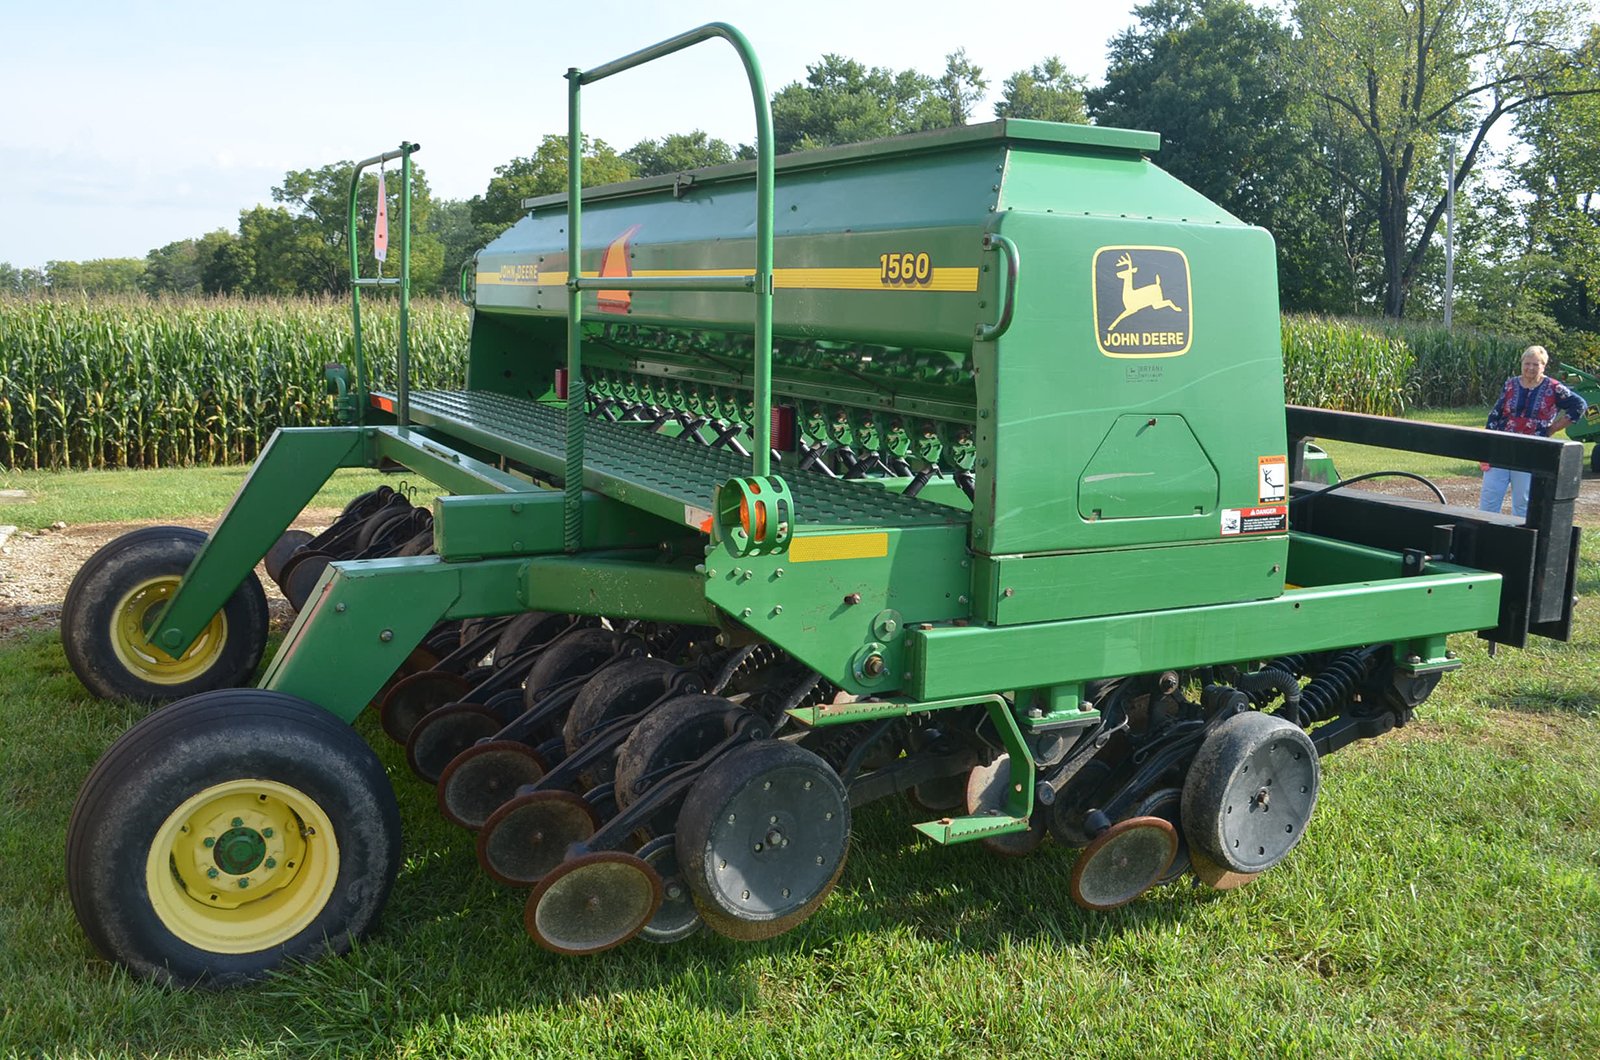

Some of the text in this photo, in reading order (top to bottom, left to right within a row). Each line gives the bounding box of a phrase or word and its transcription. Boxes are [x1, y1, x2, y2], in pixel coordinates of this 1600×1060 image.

[517, 264, 538, 279] DEERE
[880, 252, 931, 282] 1560
[1103, 332, 1184, 347] JOHN DEERE
